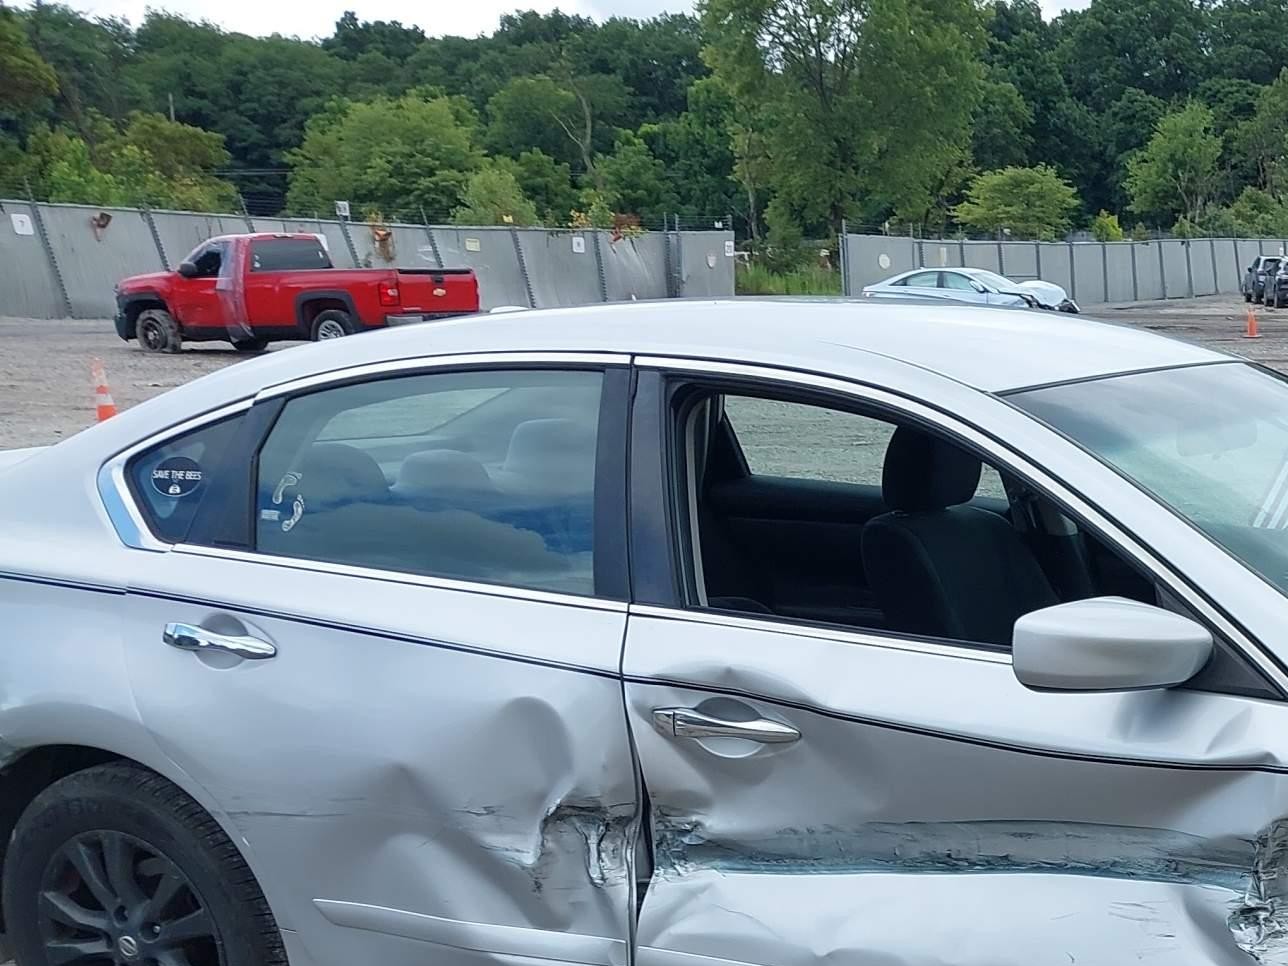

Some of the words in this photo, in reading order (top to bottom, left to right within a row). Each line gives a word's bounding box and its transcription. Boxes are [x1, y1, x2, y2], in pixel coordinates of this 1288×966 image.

[152, 470, 170, 479] SAVE
[171, 470, 185, 480] THE
[185, 471, 202, 481] BEES
